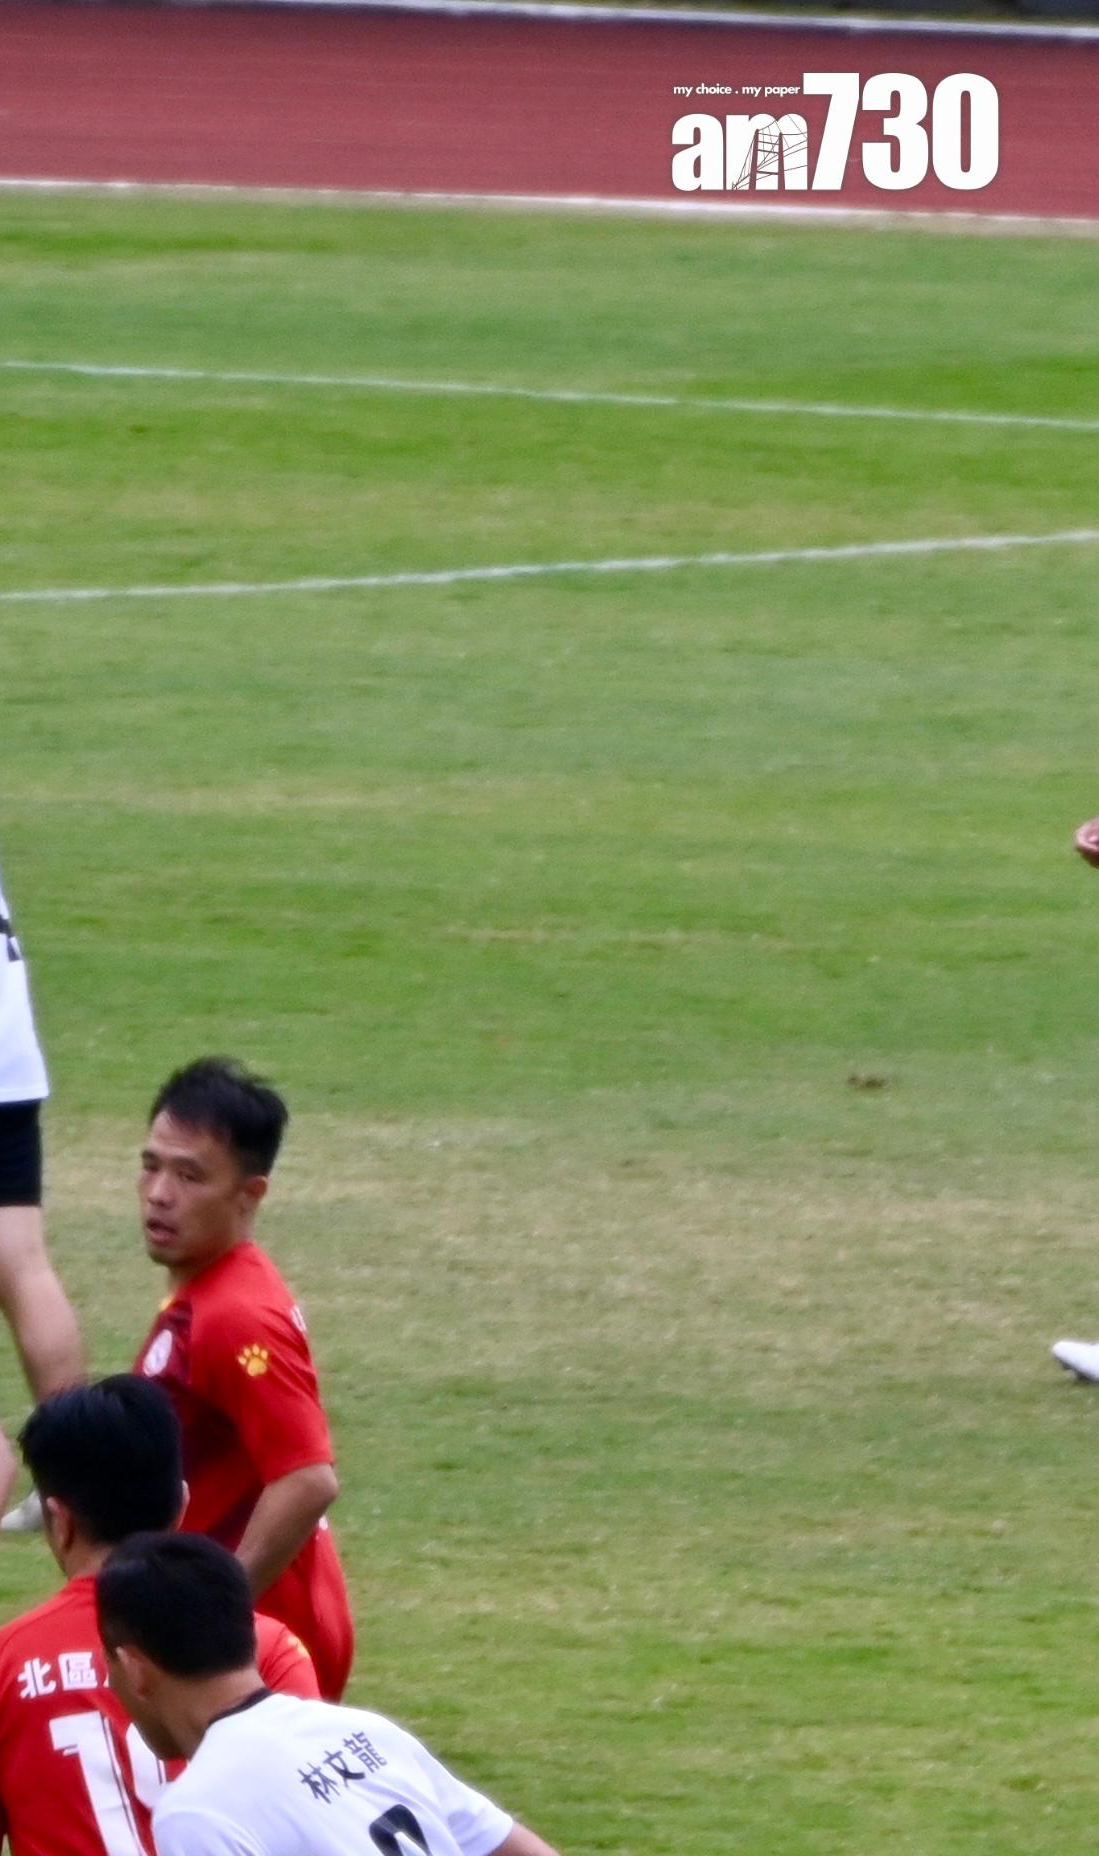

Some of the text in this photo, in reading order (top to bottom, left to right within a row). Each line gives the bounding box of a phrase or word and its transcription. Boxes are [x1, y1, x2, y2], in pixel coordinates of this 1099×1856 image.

[18, 1651, 109, 1700] 北區
[297, 1731, 387, 1804] 林文龍
